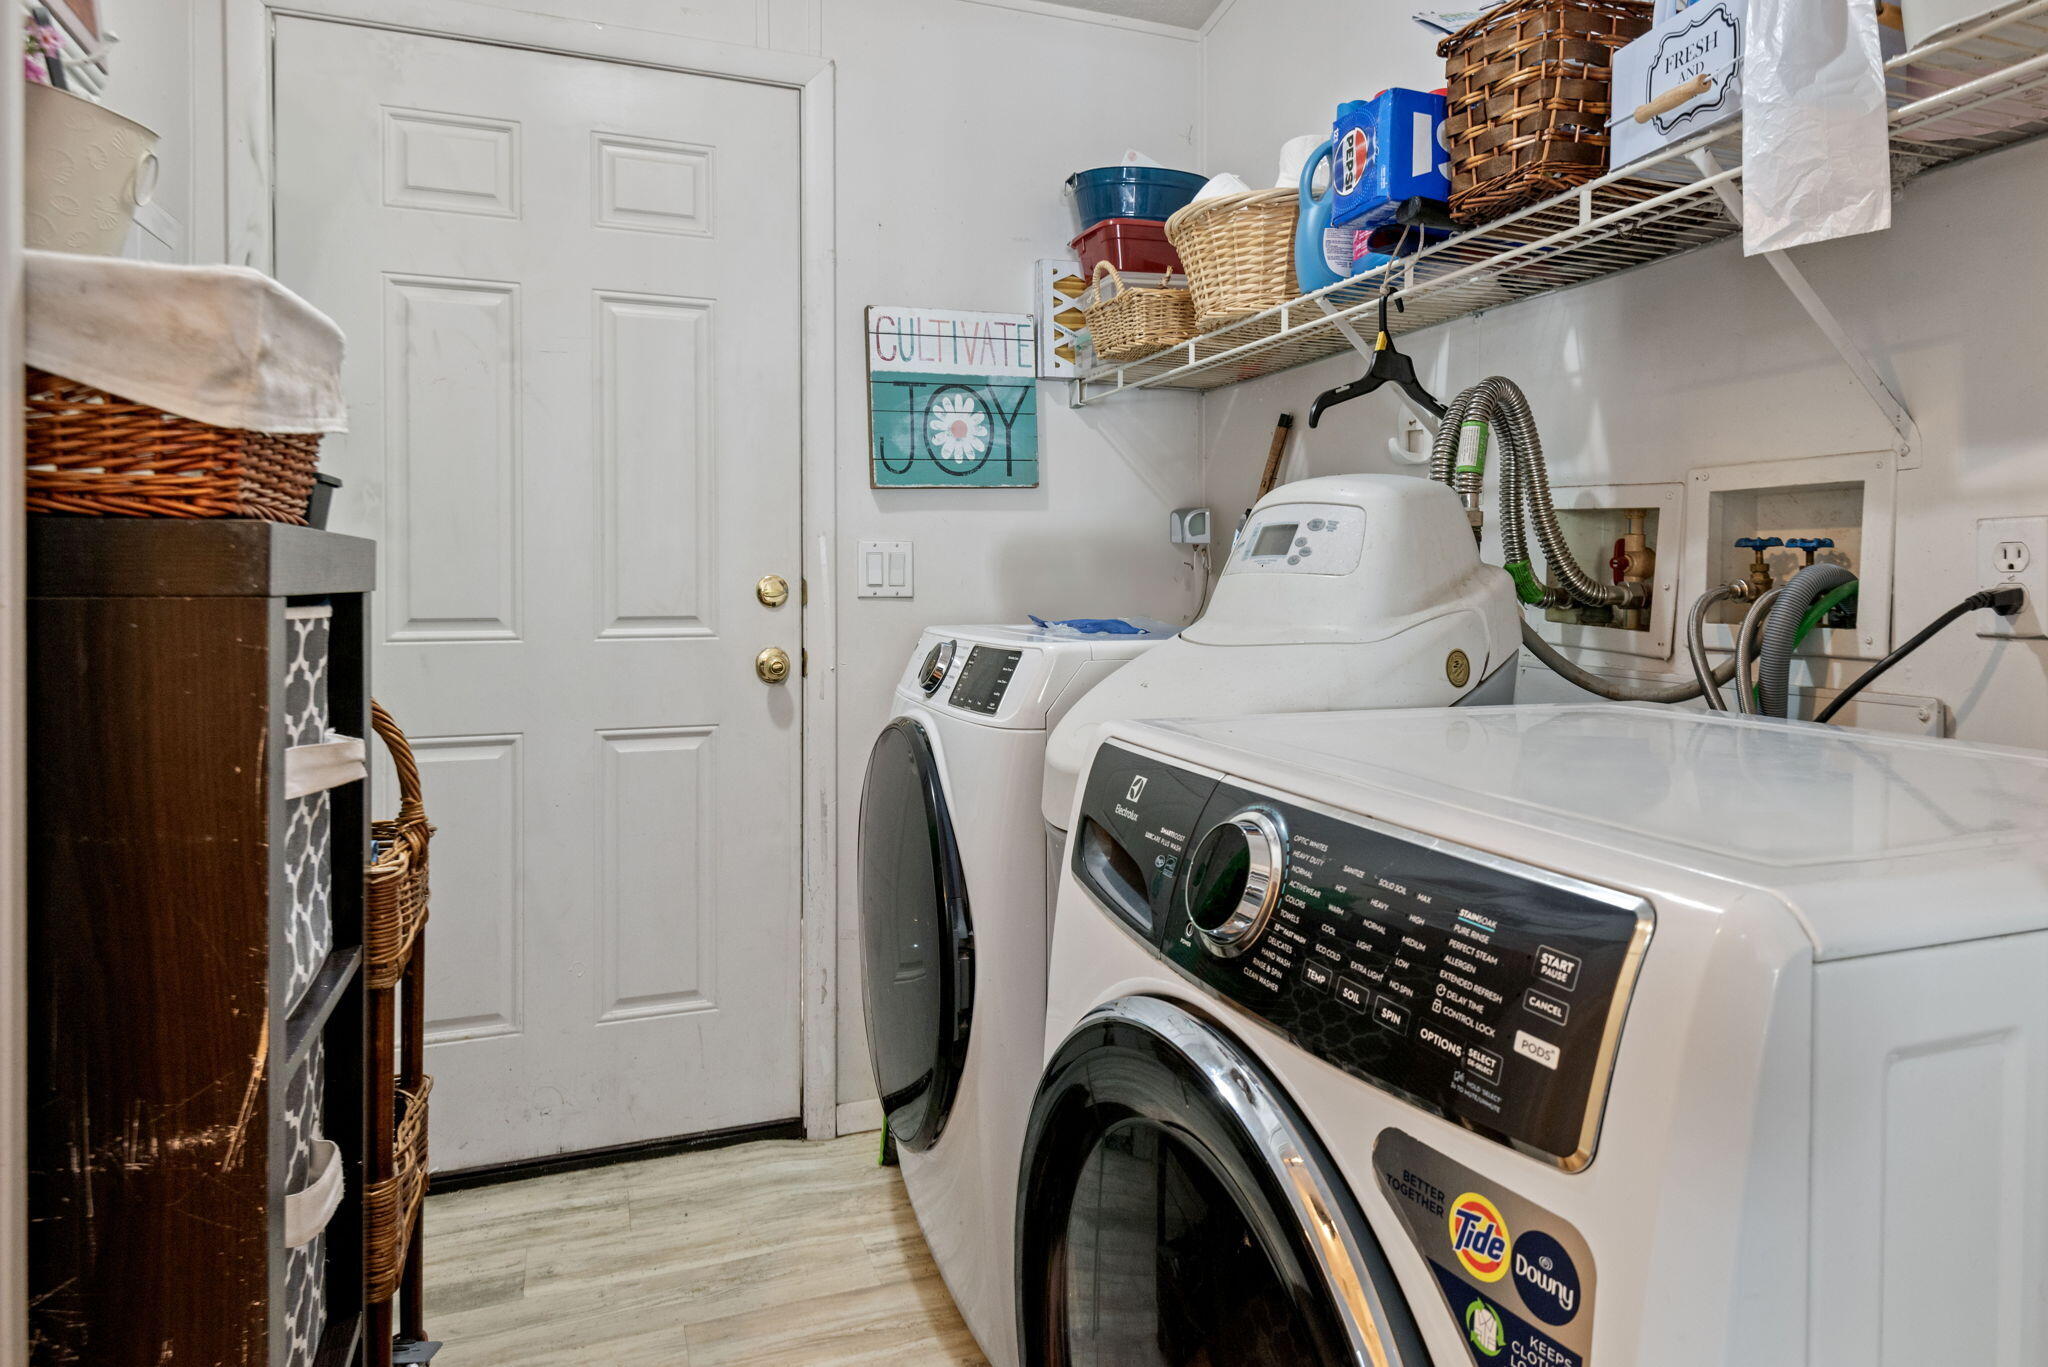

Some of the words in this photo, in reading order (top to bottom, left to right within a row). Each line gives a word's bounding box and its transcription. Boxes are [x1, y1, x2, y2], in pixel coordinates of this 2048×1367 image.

[1665, 30, 1718, 74] FRESH
[1679, 61, 1704, 83] AND
[1345, 134, 1354, 190] PEPSI
[876, 315, 1032, 368] CULTIVATE
[880, 381, 1031, 476] JOY
[1115, 804, 1139, 822] Electrolux
[1293, 834, 1310, 846] OPTIC
[1309, 840, 1328, 853] WHITES
[1292, 850, 1311, 861] HEAVY
[1309, 855, 1325, 866] DUTY
[1291, 865, 1313, 879] NORMAL
[1289, 880, 1322, 899] ACTIVEWEAR
[1335, 884, 1348, 894] HOT
[1416, 892, 1432, 905] MAX
[1284, 894, 1306, 909] COLORS
[1328, 903, 1345, 916] WARM
[1370, 898, 1390, 911] HEAVY
[1280, 909, 1300, 924] TOWELS
[1408, 913, 1426, 927] HIGH
[1459, 908, 1498, 929] STAINSOAK
[1321, 923, 1336, 936] COOL
[1362, 919, 1387, 935] NORMAL
[1453, 923, 1471, 937] PURE
[1470, 930, 1490, 945] RINSE
[1267, 935, 1293, 954] DELICATES
[1315, 943, 1327, 955] ECO
[1326, 949, 1341, 962] COLD
[1355, 939, 1373, 952] LIGHT
[1401, 935, 1427, 952] MEDIUM
[1448, 938, 1476, 956] PERFECT
[1475, 949, 1499, 966] STEAM
[1261, 947, 1276, 960] HAND
[1275, 954, 1292, 968] WASH
[1394, 957, 1410, 970] LOW
[1443, 954, 1477, 974] ALLERGEN
[1540, 952, 1576, 975] START
[1243, 966, 1260, 981] CLEAN
[1258, 975, 1280, 993] WASHER
[1307, 968, 1326, 985] TEMP
[1350, 961, 1367, 975] EXTRA
[1366, 968, 1384, 983] LIGHT
[1540, 966, 1568, 984] PAUSE
[1342, 987, 1360, 1004] SOIL
[1388, 979, 1400, 991] NO
[1399, 984, 1414, 998] SPIN
[1439, 969, 1473, 991] EXTENDED
[1473, 984, 1503, 1004] REFRESH
[1446, 990, 1468, 1006] DELAY
[1467, 999, 1485, 1015] TIME
[1528, 996, 1563, 1019] CANCEL
[1381, 1007, 1401, 1025] SPIN
[1442, 1006, 1475, 1029] CONTROL
[1475, 1021, 1496, 1038] LOCK
[1419, 1027, 1463, 1058] OPTIONS
[1467, 1047, 1497, 1069] SELECT
[1386, 1173, 1445, 1218] TOGETHER
[1402, 1169, 1446, 1204] BETTER
[1453, 1208, 1507, 1262] Tide
[1515, 1253, 1575, 1311] Downy
[1530, 1335, 1573, 1367] KEEPS
